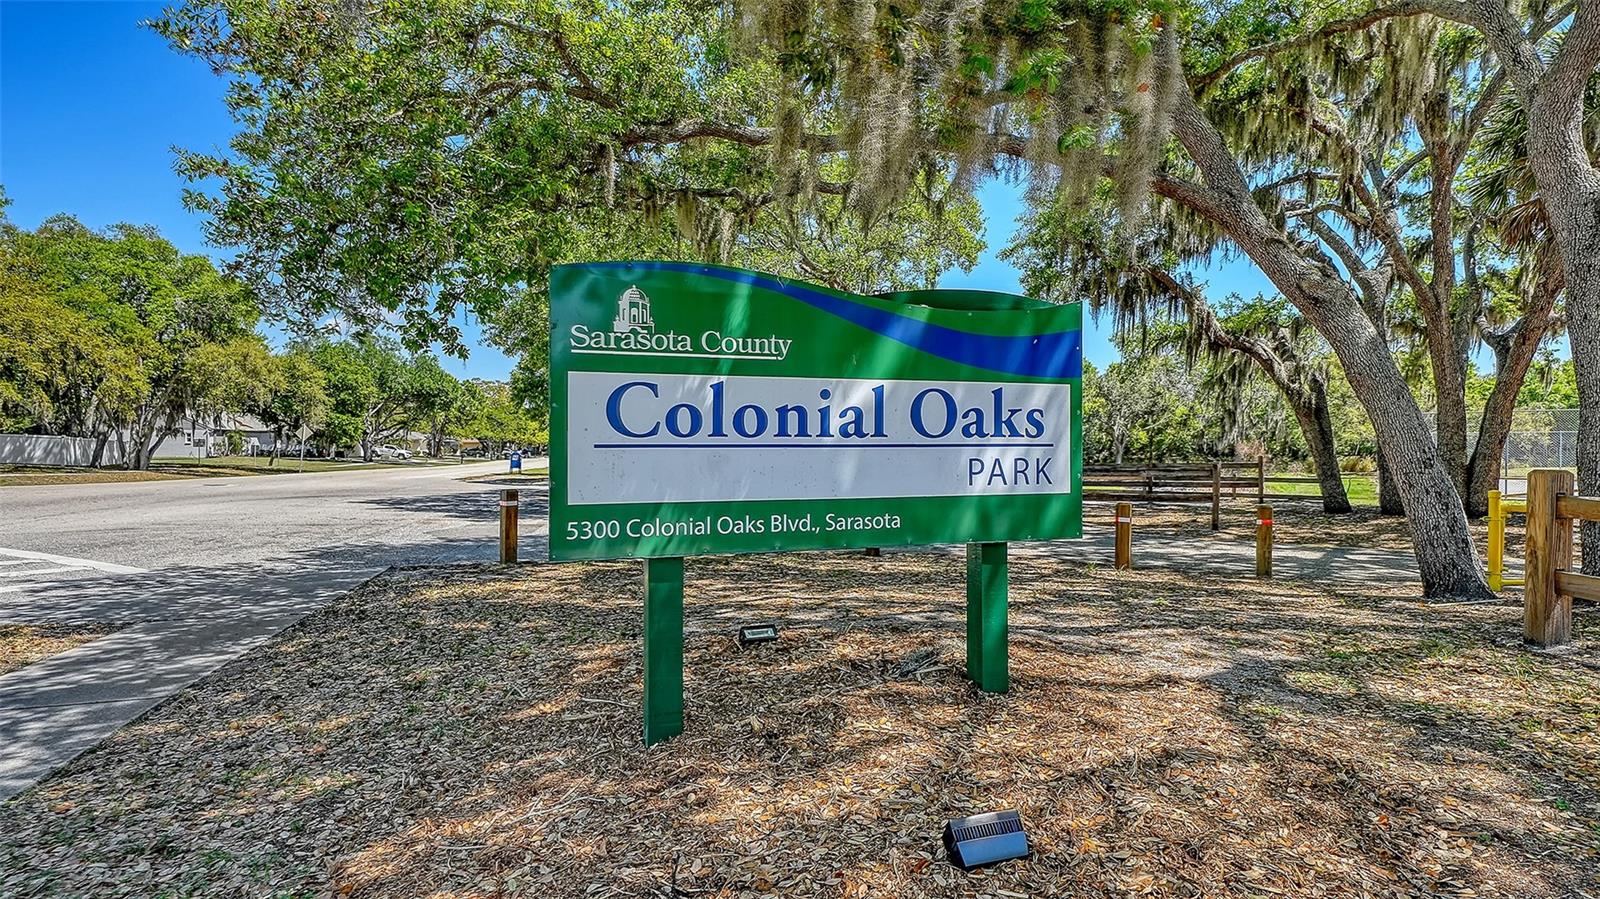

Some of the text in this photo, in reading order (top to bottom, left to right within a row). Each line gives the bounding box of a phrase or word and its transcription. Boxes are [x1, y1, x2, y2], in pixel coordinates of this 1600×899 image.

[570, 325, 792, 360] Sarasota County
[606, 380, 1045, 438] Colonial Oaks
[968, 457, 1053, 486] PARK
[566, 512, 901, 540] 5300 Colonial Oaks Blvd., Sarasota
